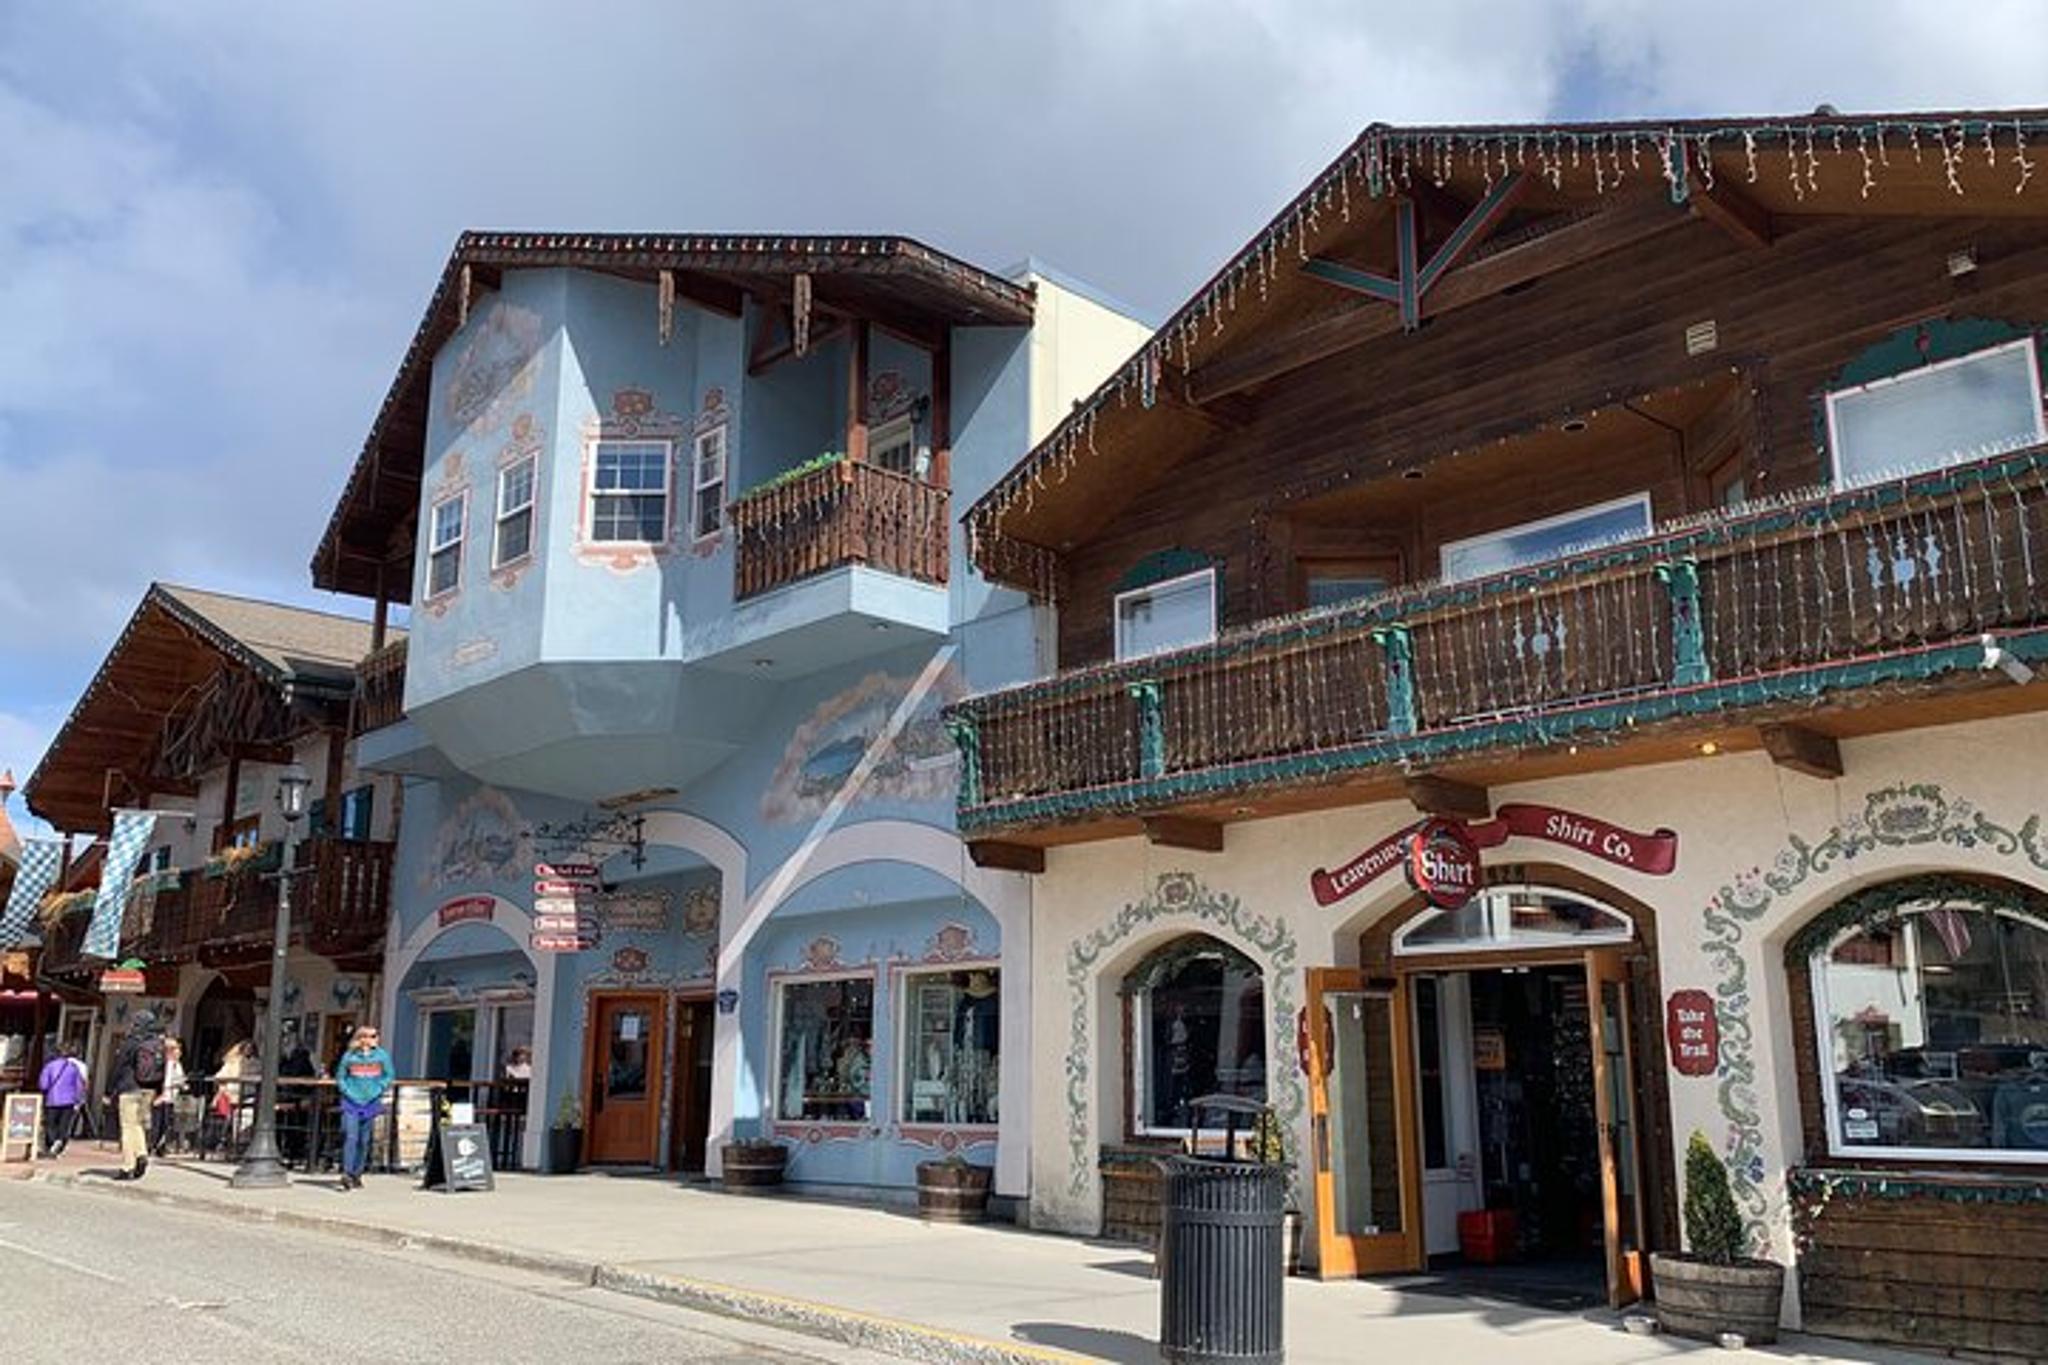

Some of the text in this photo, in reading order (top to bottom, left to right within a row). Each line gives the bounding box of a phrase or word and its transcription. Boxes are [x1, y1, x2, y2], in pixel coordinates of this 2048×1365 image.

[1546, 815, 1595, 845] Shirt
[1603, 833, 1634, 863] Co.
[1421, 849, 1474, 885] Shirt
